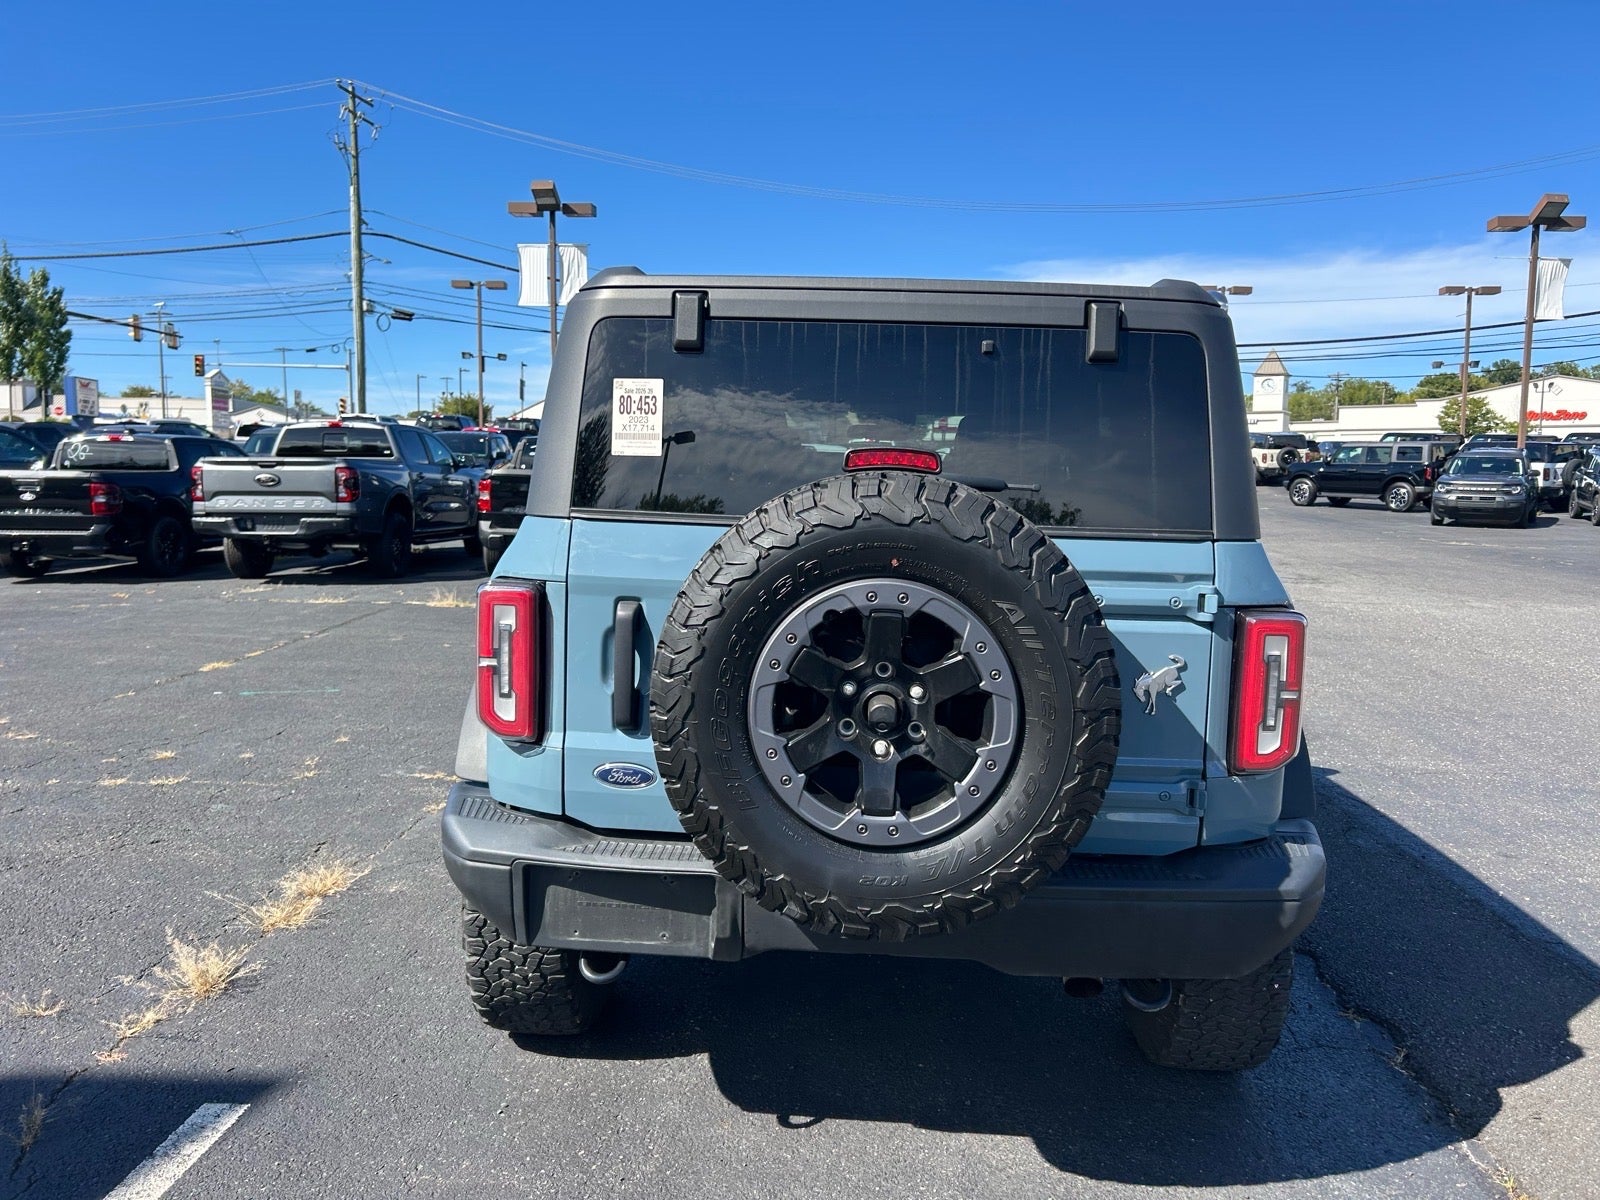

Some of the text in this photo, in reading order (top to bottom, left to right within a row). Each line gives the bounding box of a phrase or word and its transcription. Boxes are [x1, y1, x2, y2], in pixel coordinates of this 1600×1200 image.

[619, 395, 657, 415] 80:453
[628, 416, 649, 424] 2023
[1525, 409, 1587, 422] AutoZone
[621, 424, 655, 432] X17,714
[215, 498, 325, 508] RANGER
[856, 541, 919, 552] Champion
[710, 558, 821, 811] BFGoodrich
[607, 768, 642, 784] Ford
